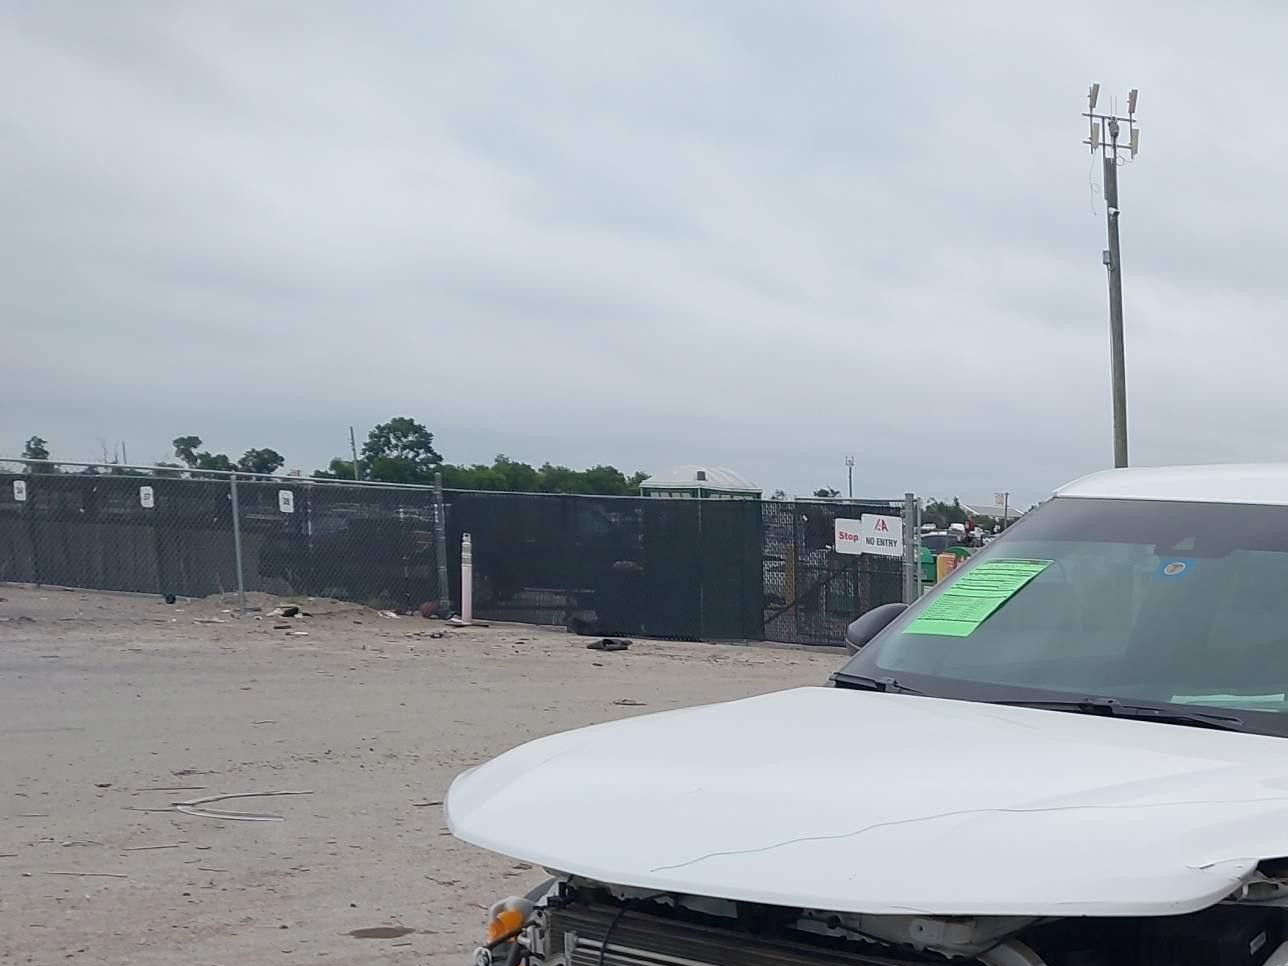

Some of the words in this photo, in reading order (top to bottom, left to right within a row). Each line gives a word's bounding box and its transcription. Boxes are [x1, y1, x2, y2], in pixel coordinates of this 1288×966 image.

[839, 531, 859, 543] Stop
[865, 537, 875, 546] NO
[876, 538, 898, 548] ENTRY
